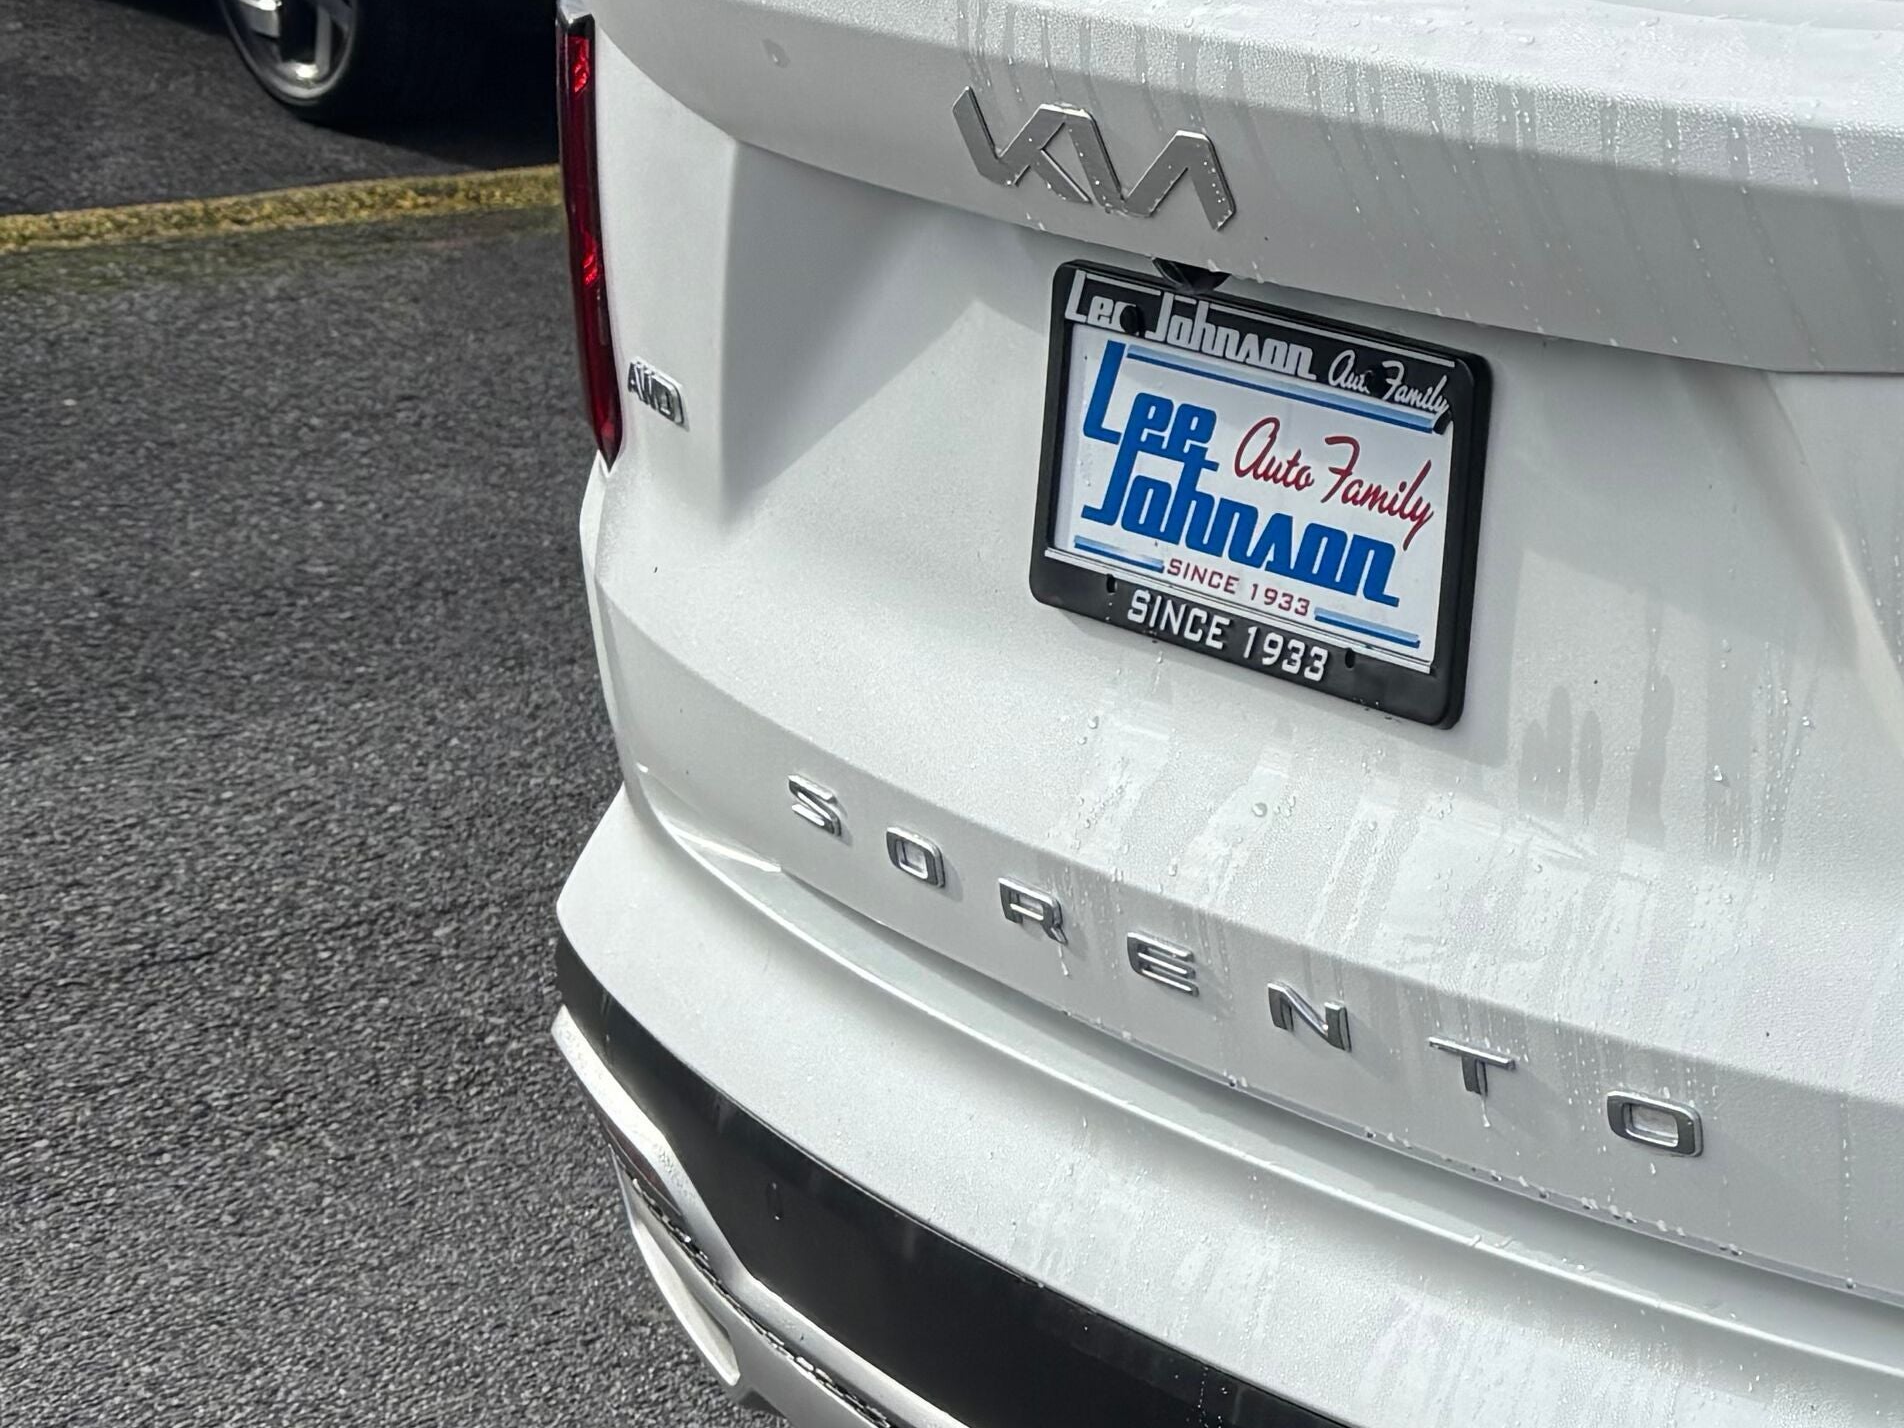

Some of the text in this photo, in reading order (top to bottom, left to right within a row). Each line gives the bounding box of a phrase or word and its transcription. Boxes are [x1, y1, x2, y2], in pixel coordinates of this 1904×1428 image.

[952, 86, 1237, 231] KIA
[1082, 340, 1218, 455] Lee
[1145, 290, 1318, 381] Johnson
[1381, 360, 1451, 422] Family
[1080, 442, 1401, 608] Johnson
[1233, 416, 1434, 552] Auto Family
[1126, 589, 1330, 683] SINCE 1933
[1166, 558, 1311, 617] SINCE 1933
[787, 772, 1705, 1158] SORENTO
